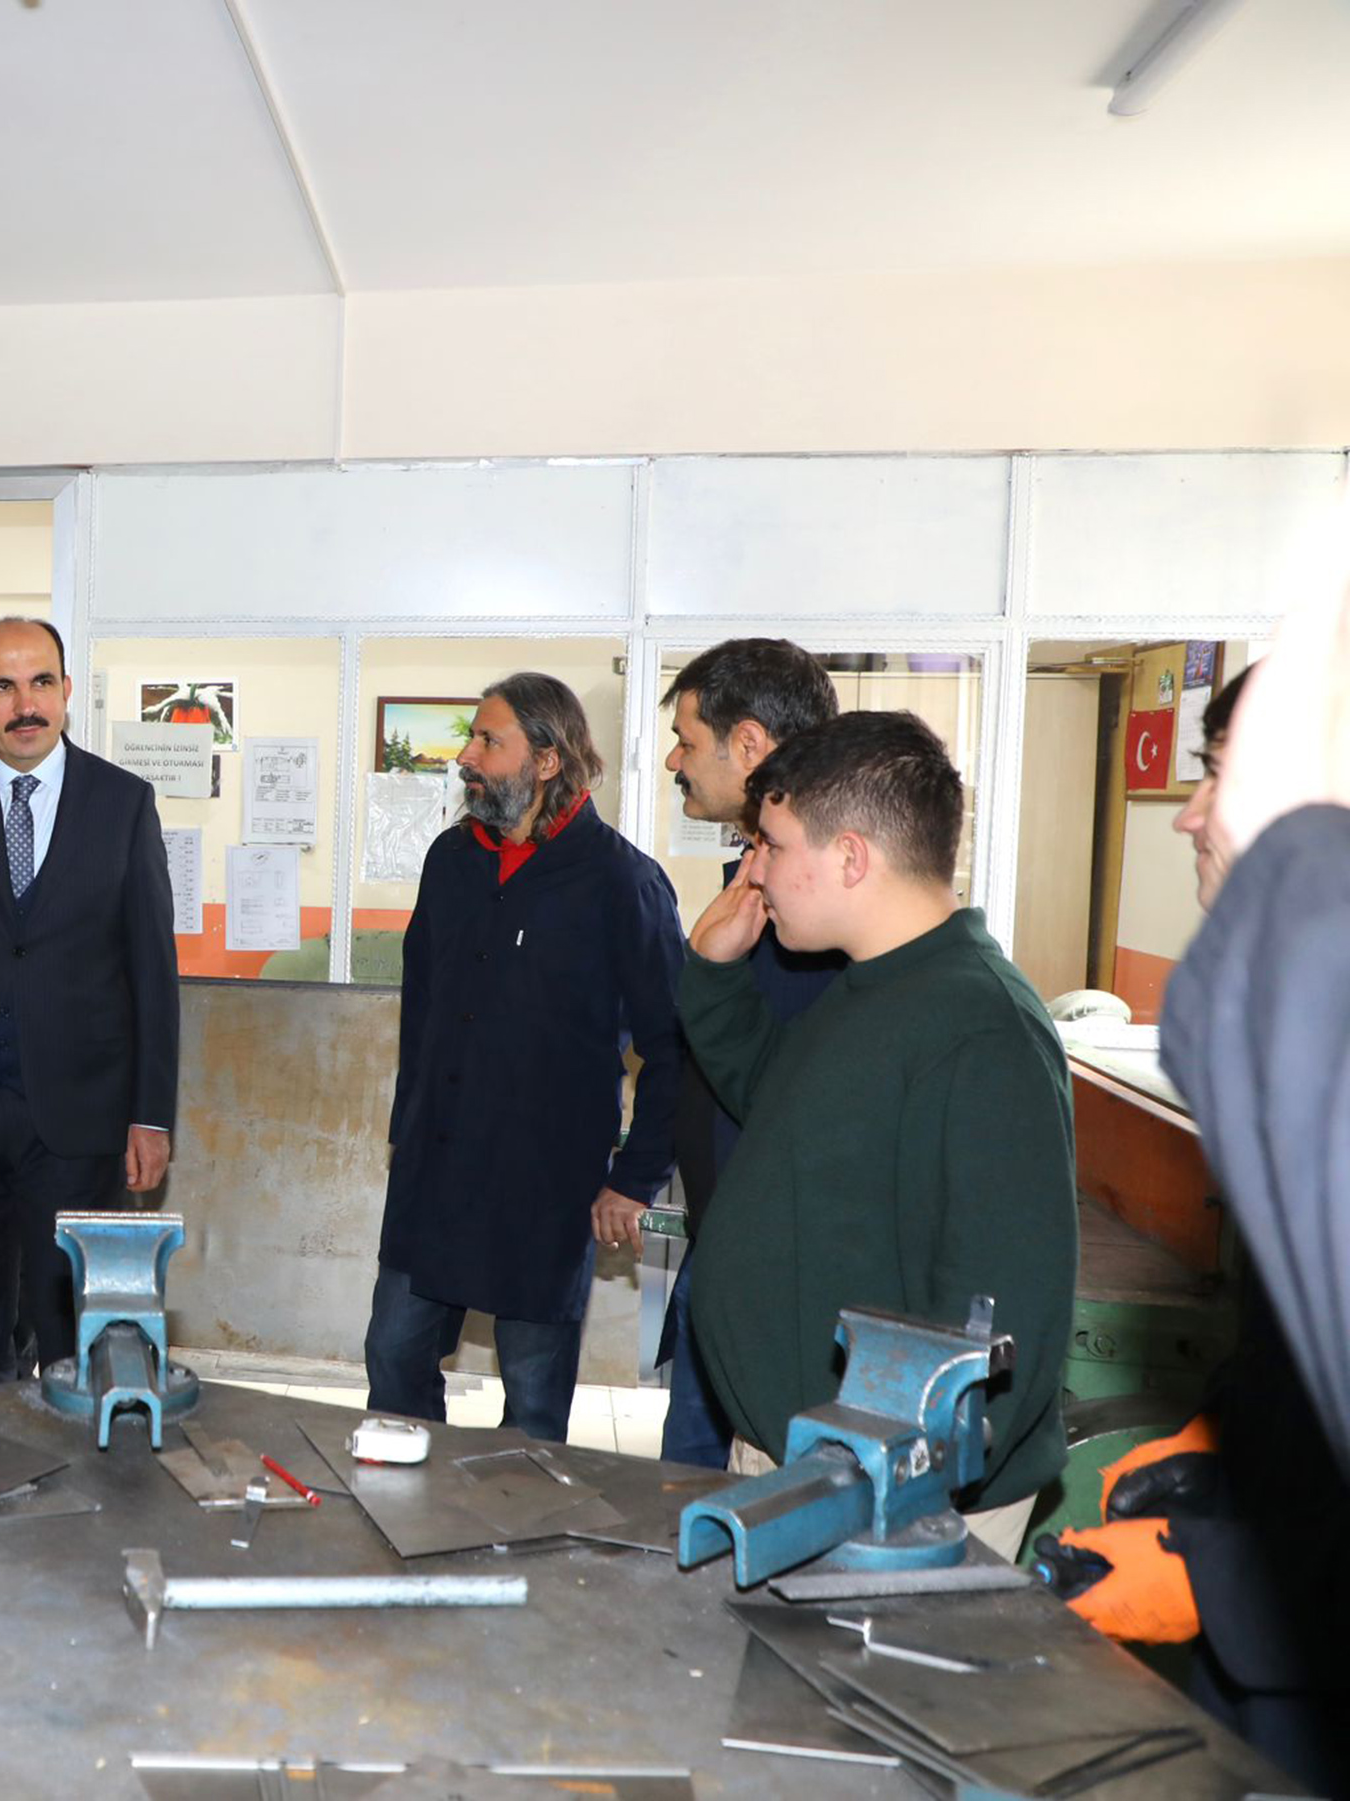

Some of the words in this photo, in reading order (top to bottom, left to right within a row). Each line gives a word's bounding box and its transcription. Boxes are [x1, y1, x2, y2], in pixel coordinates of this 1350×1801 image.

[124, 742, 171, 752] ÖĞRENCİNİN
[173, 743, 199, 752] İZİNSİZ
[119, 759, 150, 767] GİRMESİ
[163, 760, 204, 768] OTURMASI
